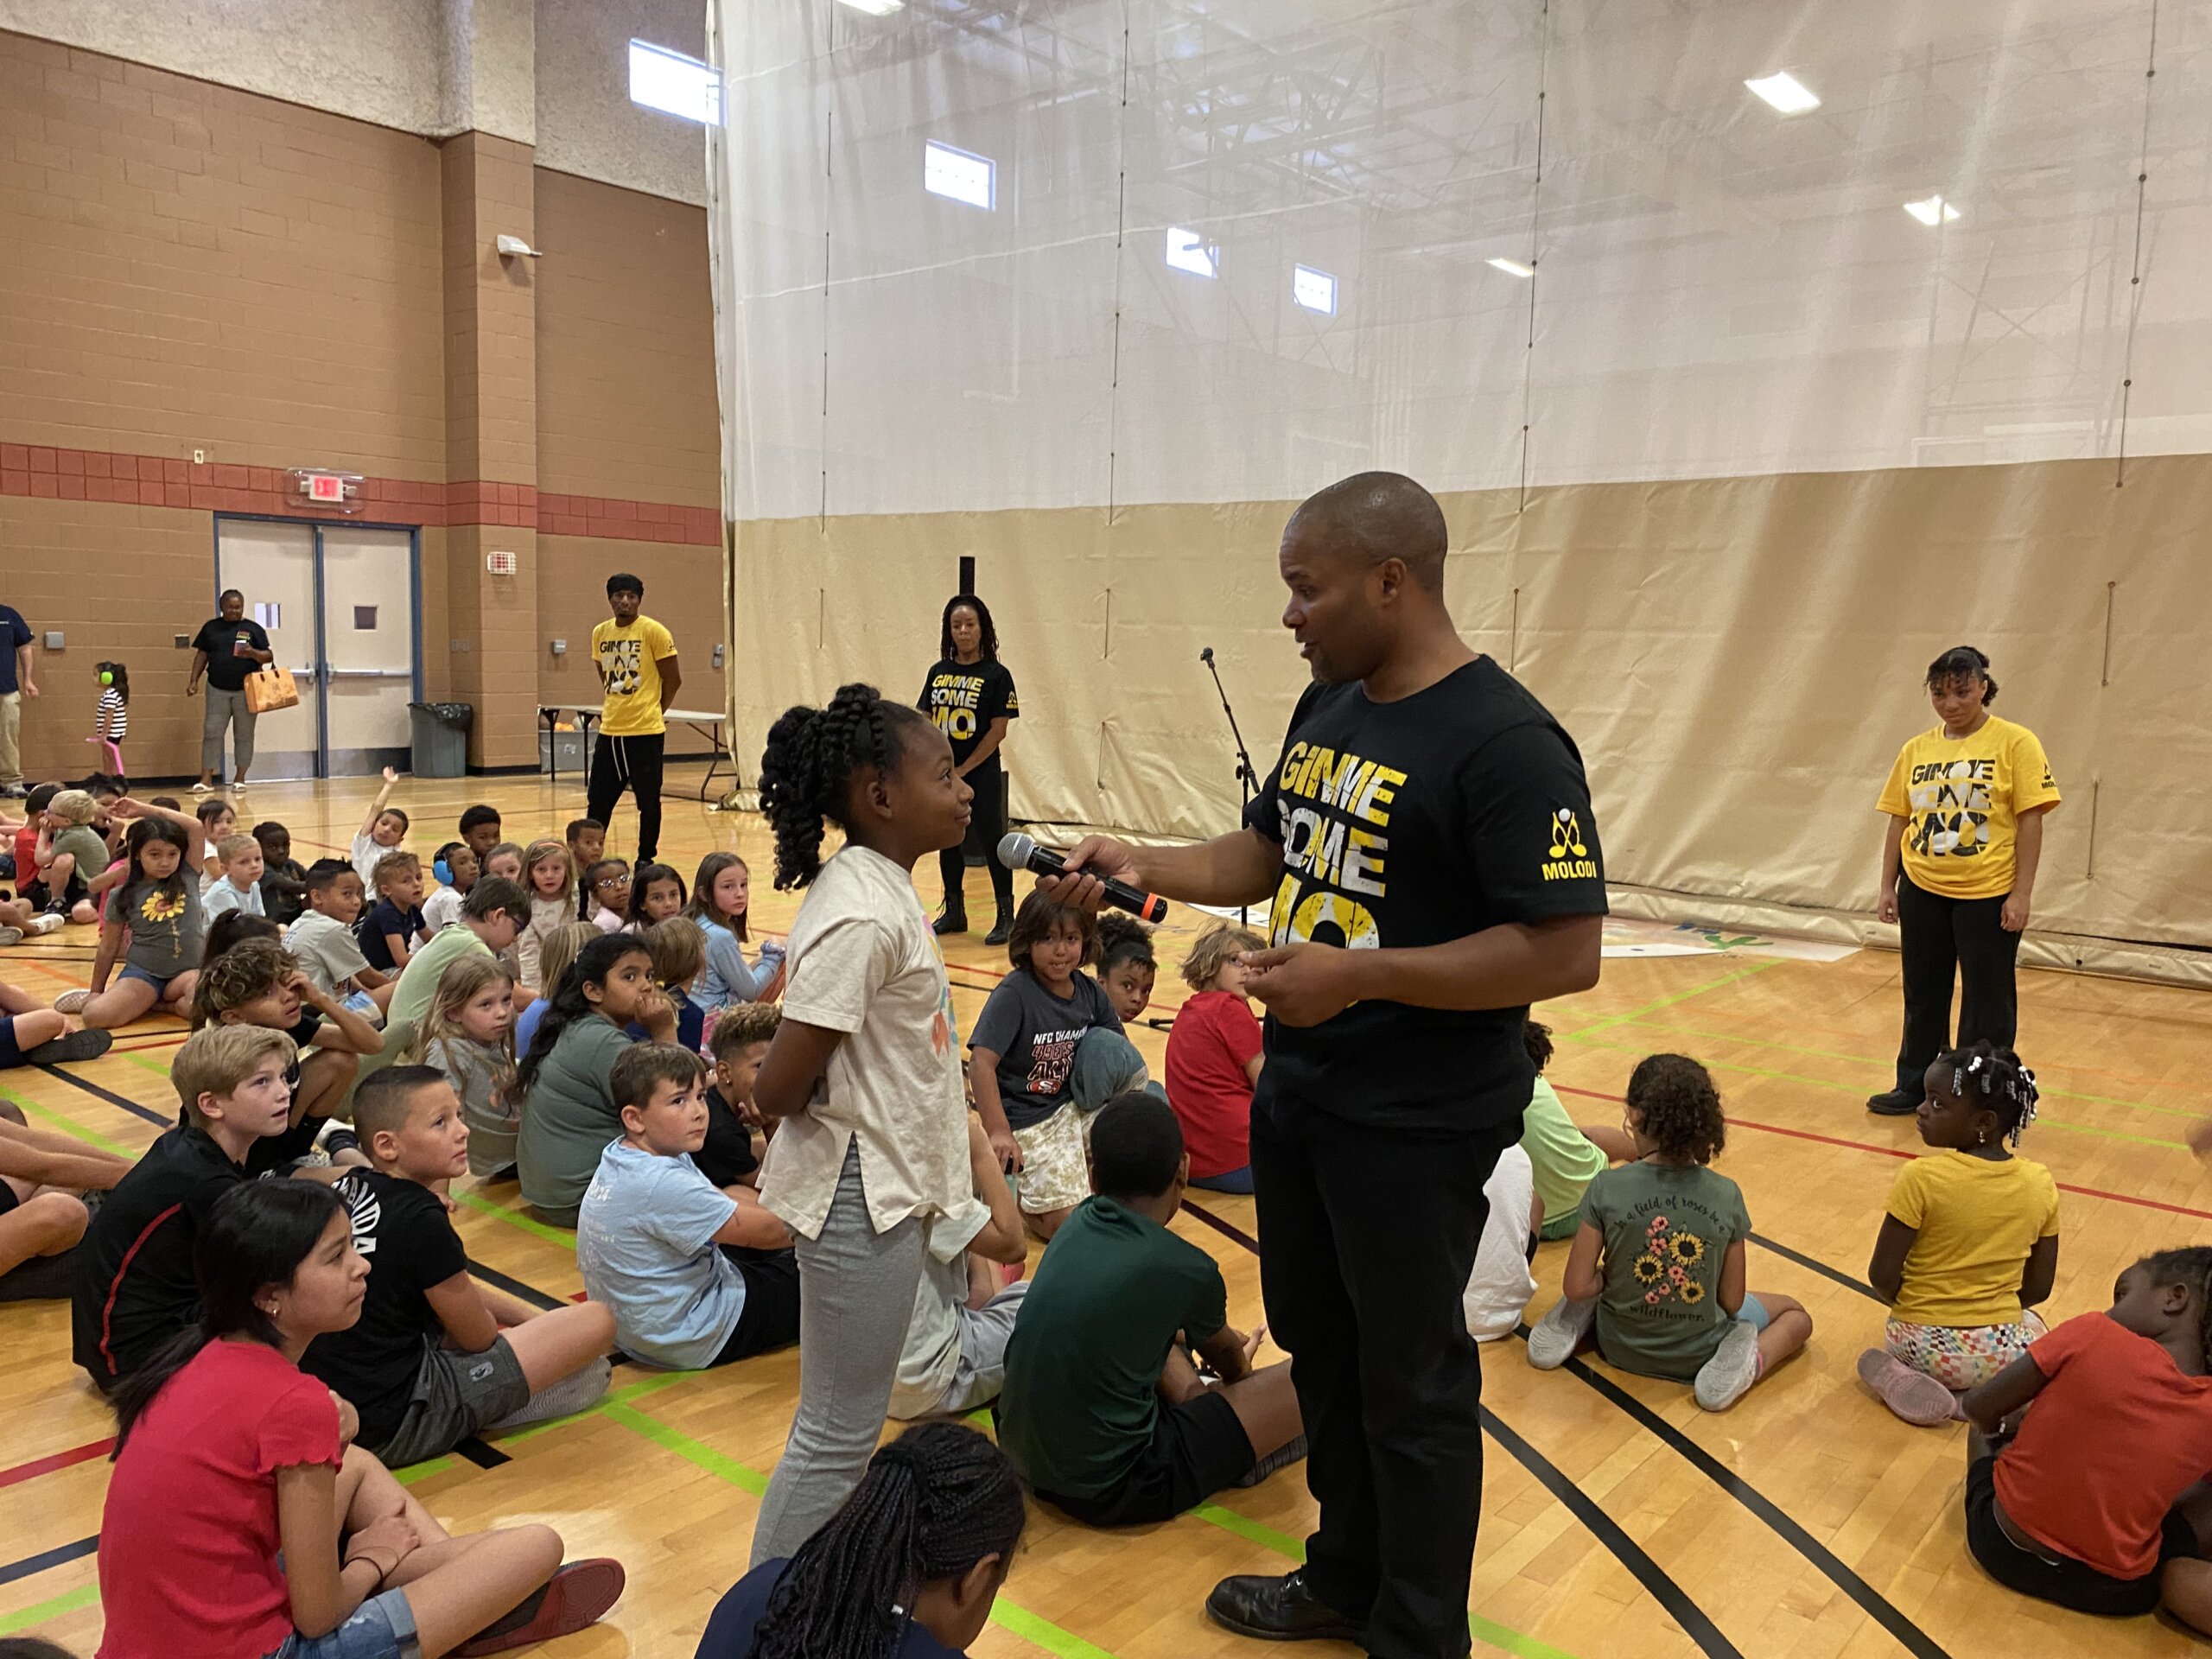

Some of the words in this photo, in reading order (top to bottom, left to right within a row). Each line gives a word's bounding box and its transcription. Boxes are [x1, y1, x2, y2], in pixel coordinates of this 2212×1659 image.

[932, 674, 984, 692] GIMME
[931, 689, 980, 709] SOME
[1280, 741, 1408, 827] GIMME
[1277, 799, 1389, 898] SOME
[1541, 860, 1597, 881] MOLODI
[1033, 1033, 1053, 1046] NFC
[1634, 1197, 1660, 1216] field
[1666, 1195, 1676, 1210] of
[1682, 1198, 1707, 1215] roses
